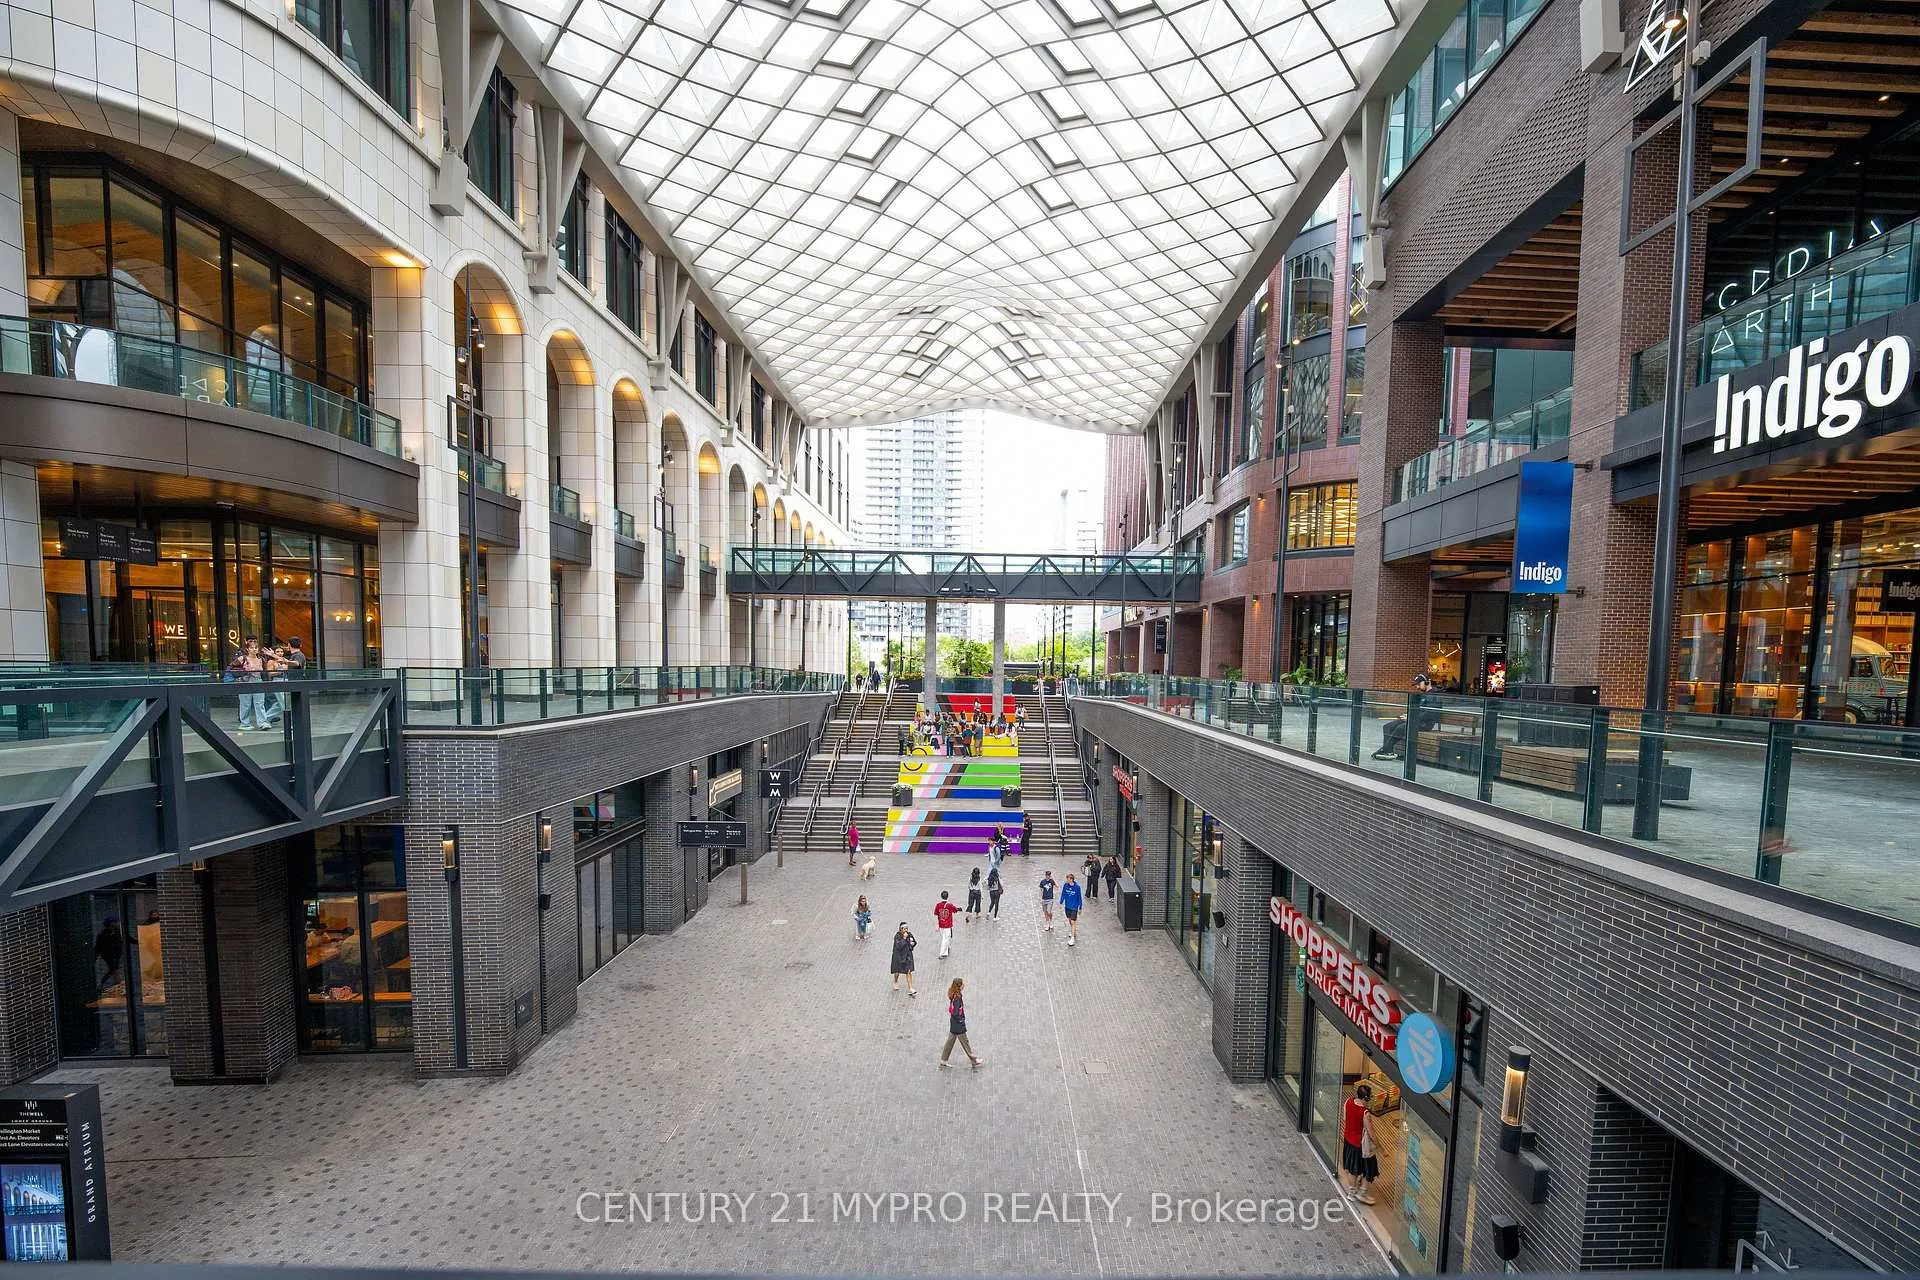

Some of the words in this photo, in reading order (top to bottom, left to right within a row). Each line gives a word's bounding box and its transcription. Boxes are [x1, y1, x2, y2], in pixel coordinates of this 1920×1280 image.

[1713, 335, 1911, 454] Indigo
[1520, 561, 1562, 585] Indigo
[1269, 897, 1391, 1025] SHOPPERS
[1306, 960, 1341, 1007] DRUG
[1343, 997, 1390, 1051] MART
[81, 1121, 94, 1172] ATRIUM
[85, 1178, 97, 1223] GRAND
